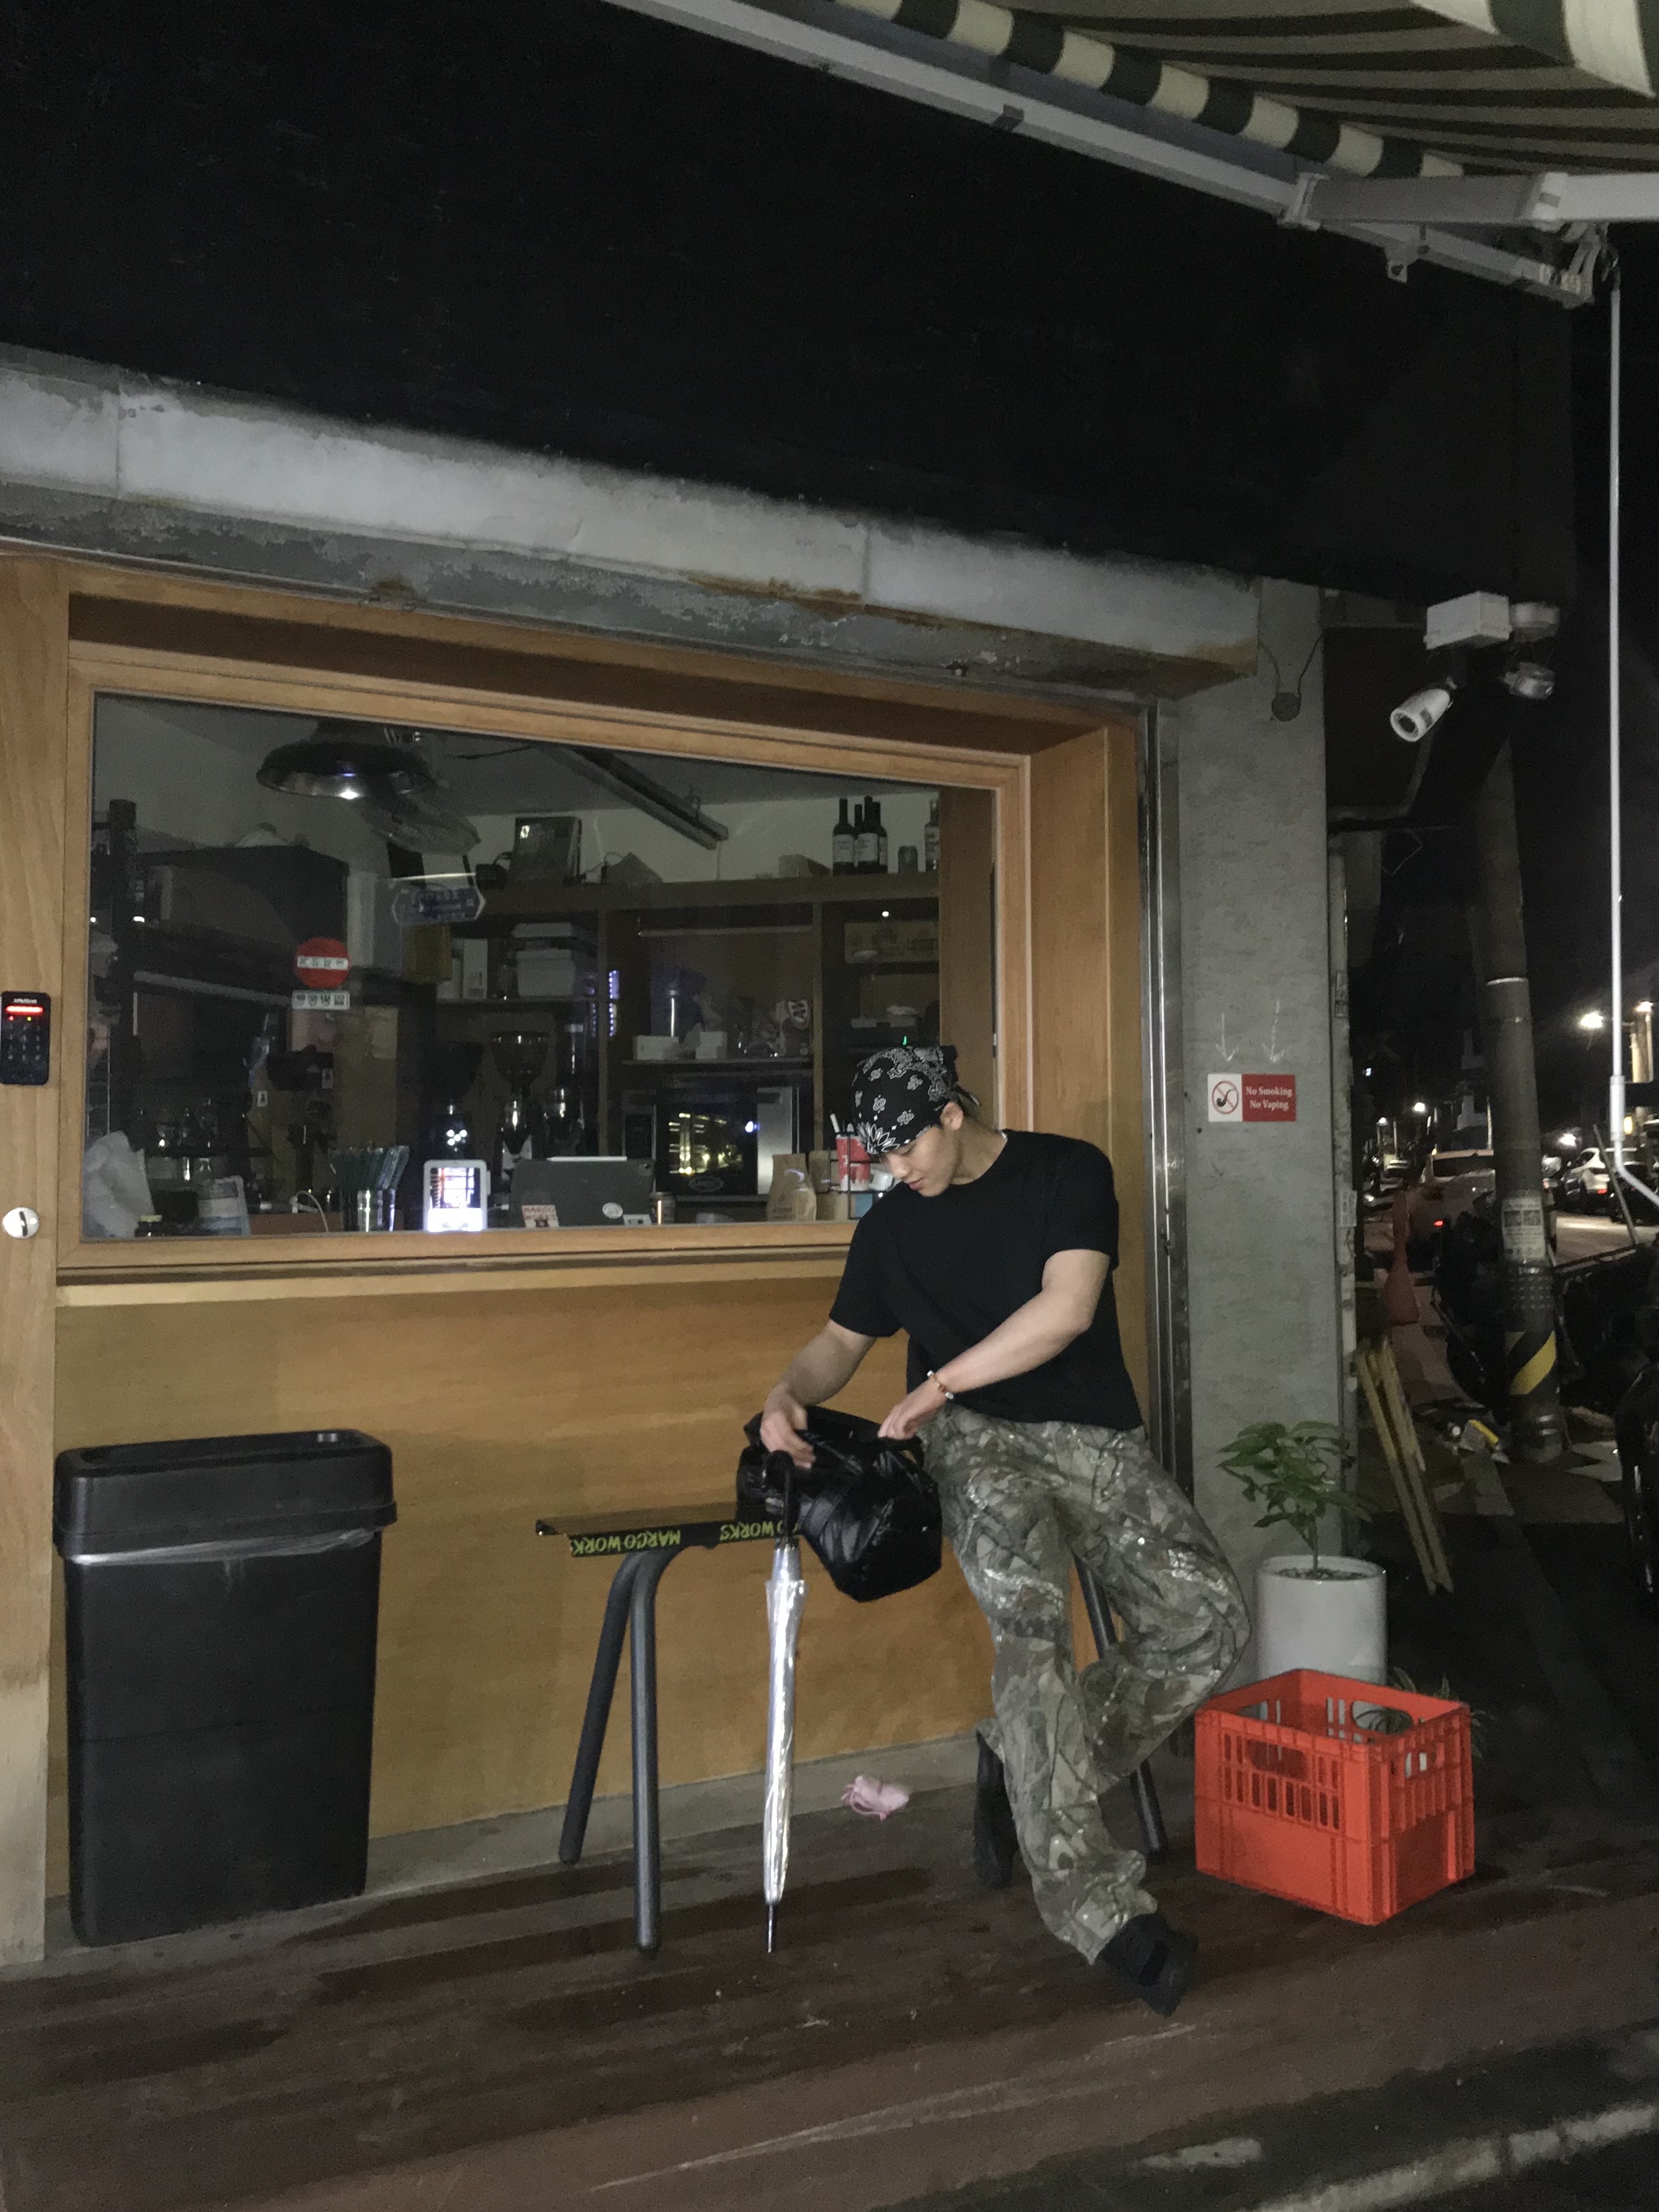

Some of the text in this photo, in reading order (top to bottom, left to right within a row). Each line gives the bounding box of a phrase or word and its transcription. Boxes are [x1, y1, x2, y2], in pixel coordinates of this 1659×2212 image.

[1246, 1086, 1292, 1098] No Smoking
[1249, 1100, 1289, 1111] No Vaping
[719, 1520, 775, 1541] WORKS
[572, 1529, 681, 1556] MARCO WORK
